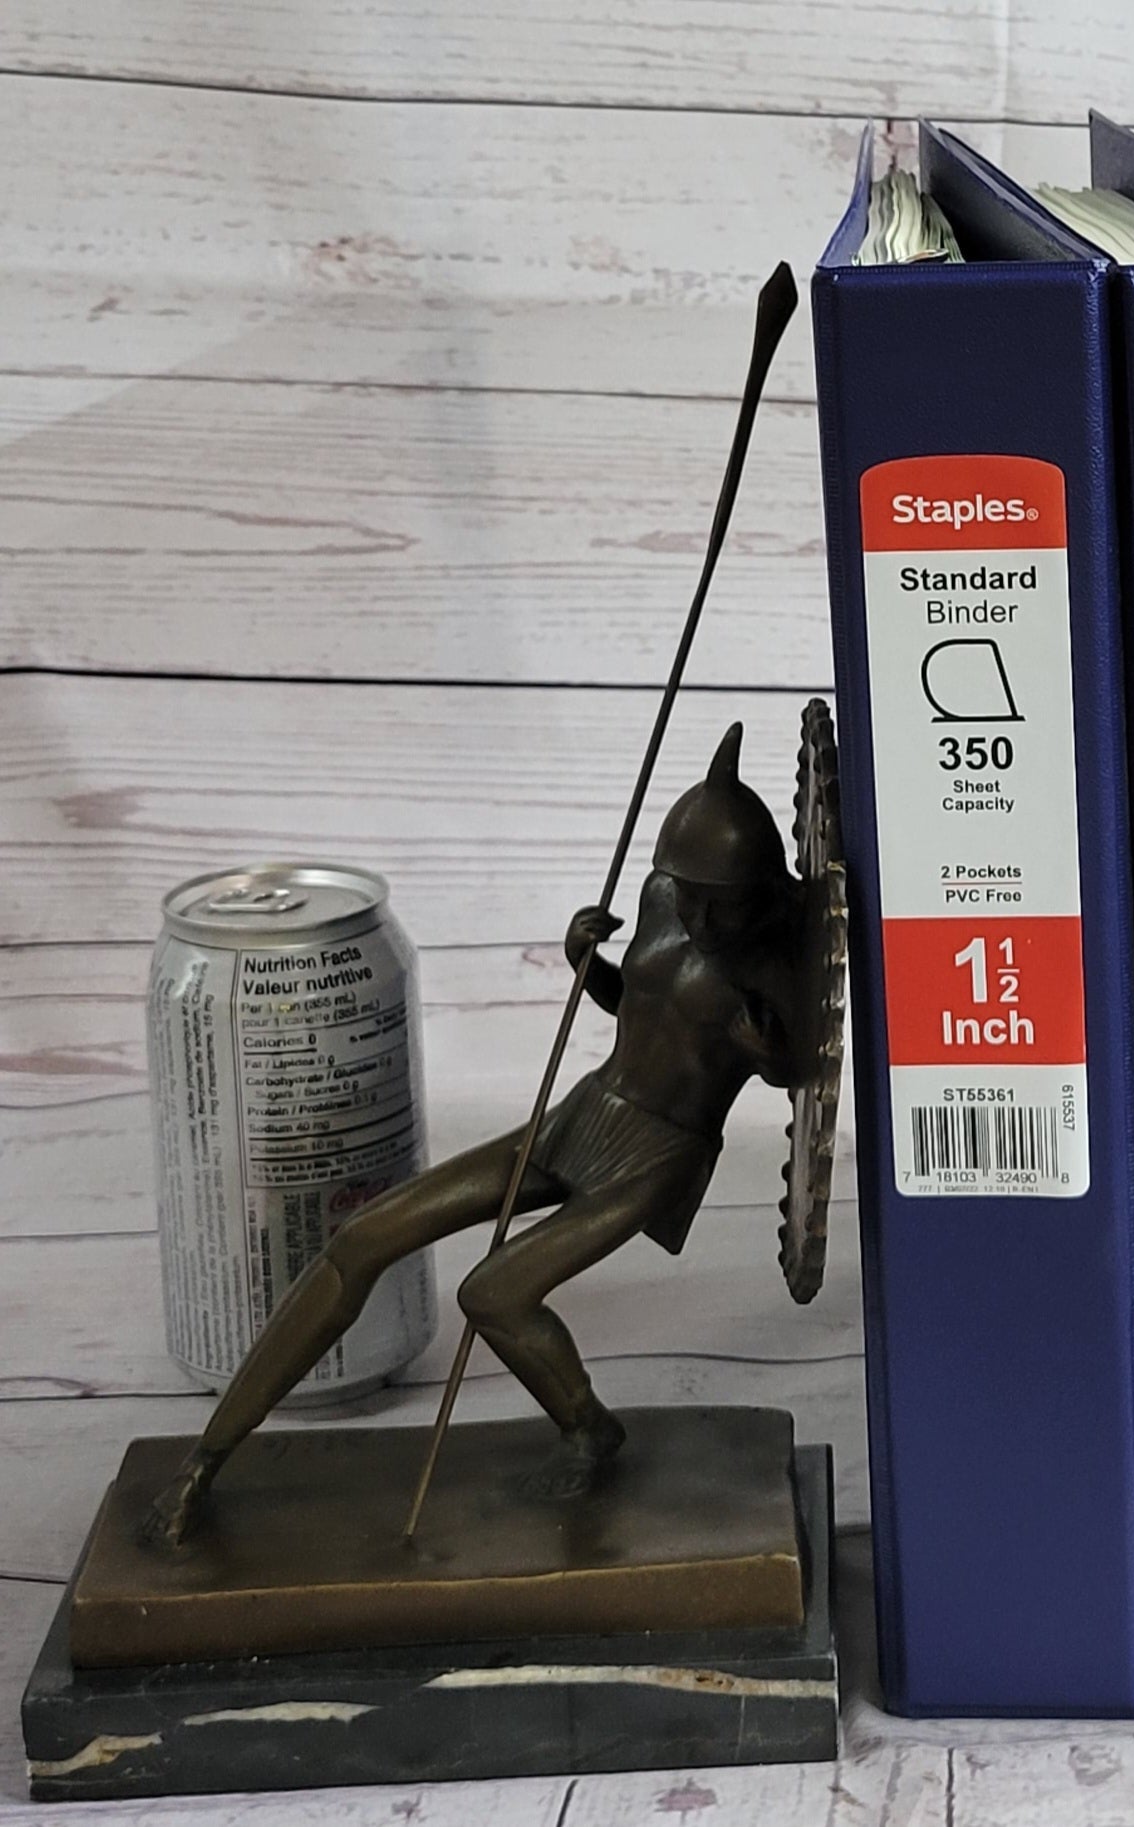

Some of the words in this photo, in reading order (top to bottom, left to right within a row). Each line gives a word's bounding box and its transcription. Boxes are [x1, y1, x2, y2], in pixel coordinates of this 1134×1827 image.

[900, 565, 1038, 591] Standard
[927, 600, 1019, 625] Binder
[938, 736, 1014, 771] 350
[953, 780, 1001, 794] Sheet
[942, 797, 1015, 814] Capacity
[940, 866, 951, 879] 2
[956, 865, 1022, 879] Pockets
[945, 889, 980, 903] PVC
[986, 889, 1022, 903] Free
[244, 955, 316, 973] Nutrition
[320, 946, 361, 967] Facts
[243, 979, 301, 995] Valeur
[306, 966, 373, 991] nutritive
[942, 1010, 1036, 1045] Inch
[243, 1036, 303, 1048] Calories
[308, 1033, 316, 1045] 0
[943, 1088, 1015, 1103] ST55361
[1061, 1084, 1076, 1131] 615537
[902, 1172, 911, 1183] 7
[937, 1171, 977, 1184] 18103
[995, 1171, 1038, 1184] 32490
[1061, 1172, 1070, 1184] 8
